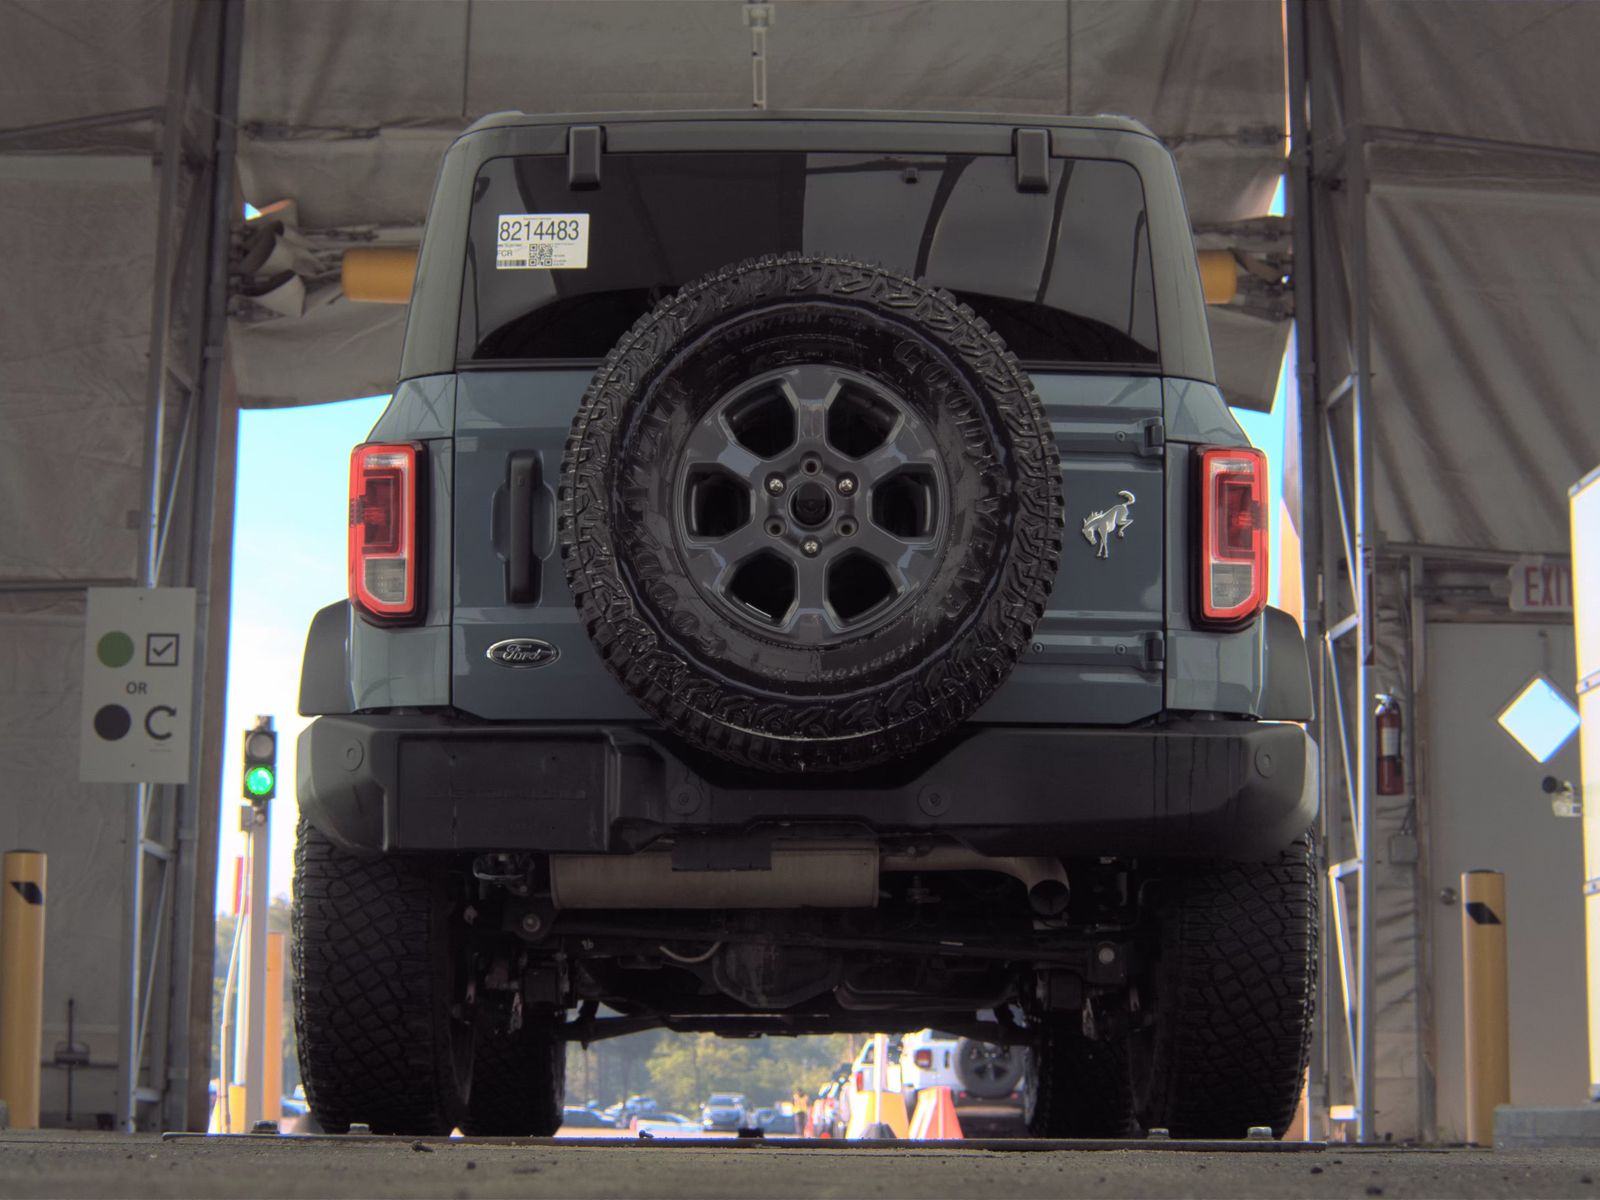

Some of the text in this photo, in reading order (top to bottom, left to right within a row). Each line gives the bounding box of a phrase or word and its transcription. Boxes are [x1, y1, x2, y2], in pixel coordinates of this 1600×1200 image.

[499, 219, 579, 241] 8214483
[1525, 565, 1573, 606] EXIT
[502, 643, 542, 661] Ford
[126, 681, 148, 695] OR
